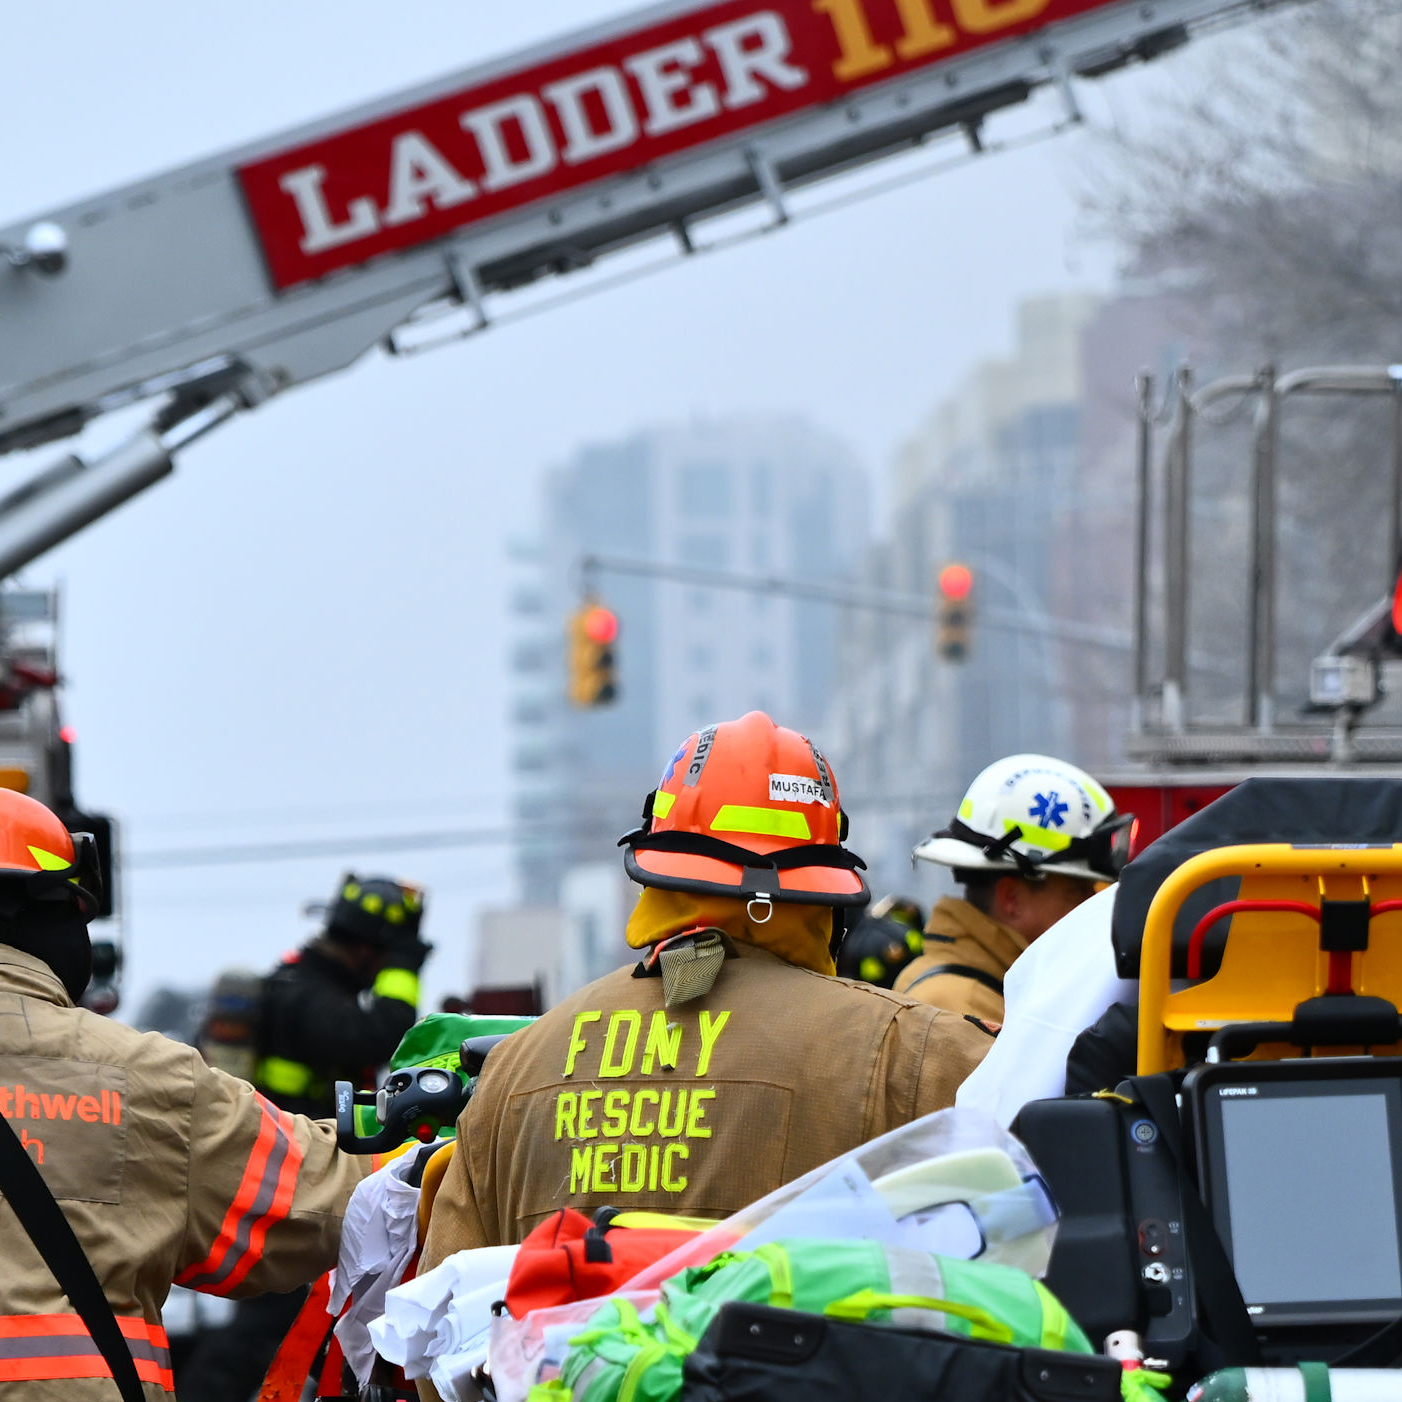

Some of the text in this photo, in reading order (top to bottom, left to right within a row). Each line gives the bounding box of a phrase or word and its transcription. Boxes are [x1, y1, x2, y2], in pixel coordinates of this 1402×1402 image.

[280, 9, 807, 254] LADDER
[771, 780, 825, 798] MUSTAFA
[563, 1010, 731, 1078] FDNY
[555, 1089, 716, 1140] RESCUE
[570, 1143, 689, 1194] MEDIC
